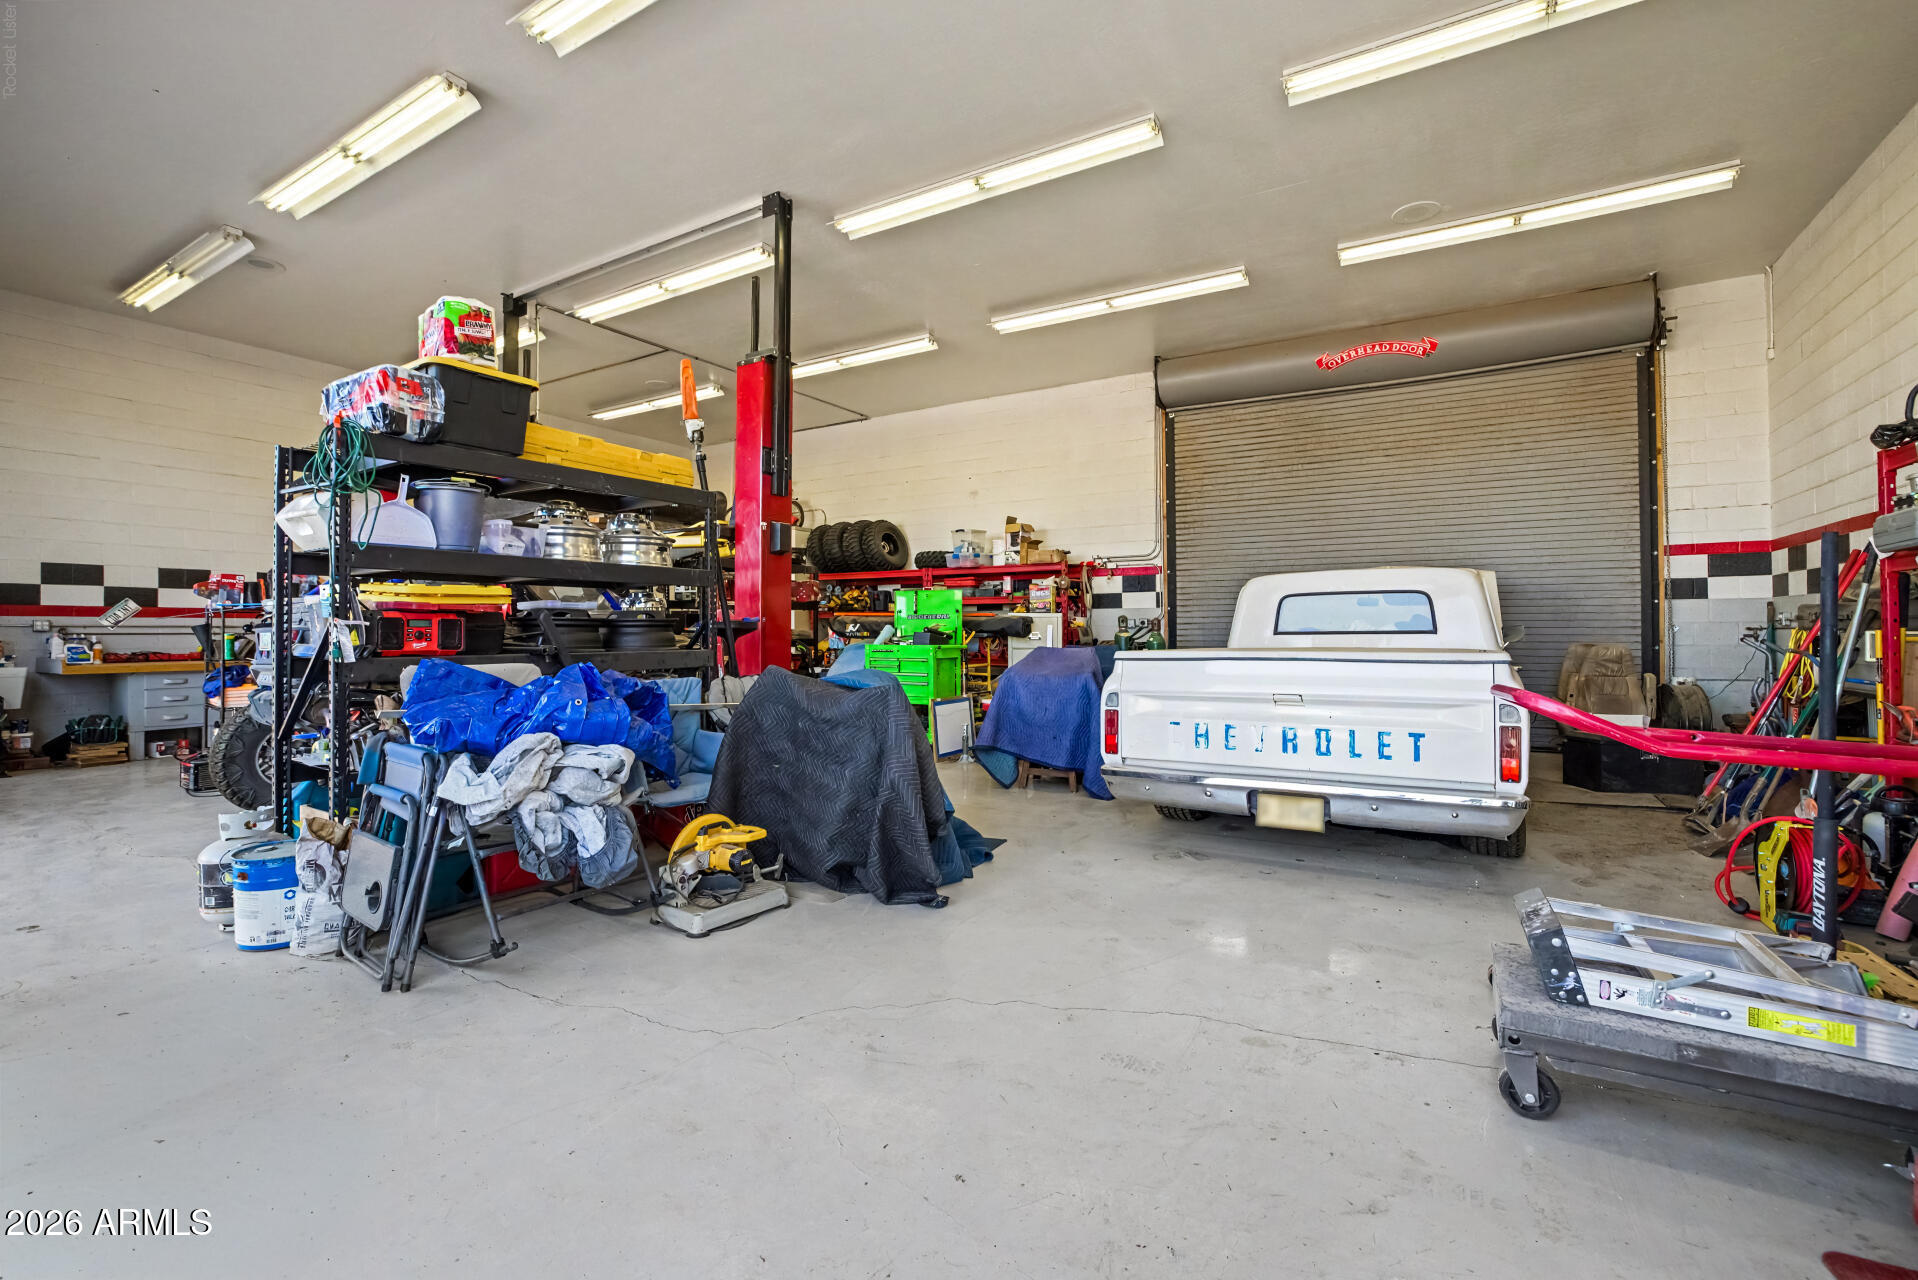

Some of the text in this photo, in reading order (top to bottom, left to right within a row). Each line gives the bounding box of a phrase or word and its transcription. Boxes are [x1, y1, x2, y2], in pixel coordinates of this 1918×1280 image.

[1328, 343, 1424, 368] OVERHEAD DOOR
[1812, 858, 1826, 932] DAYTONA
